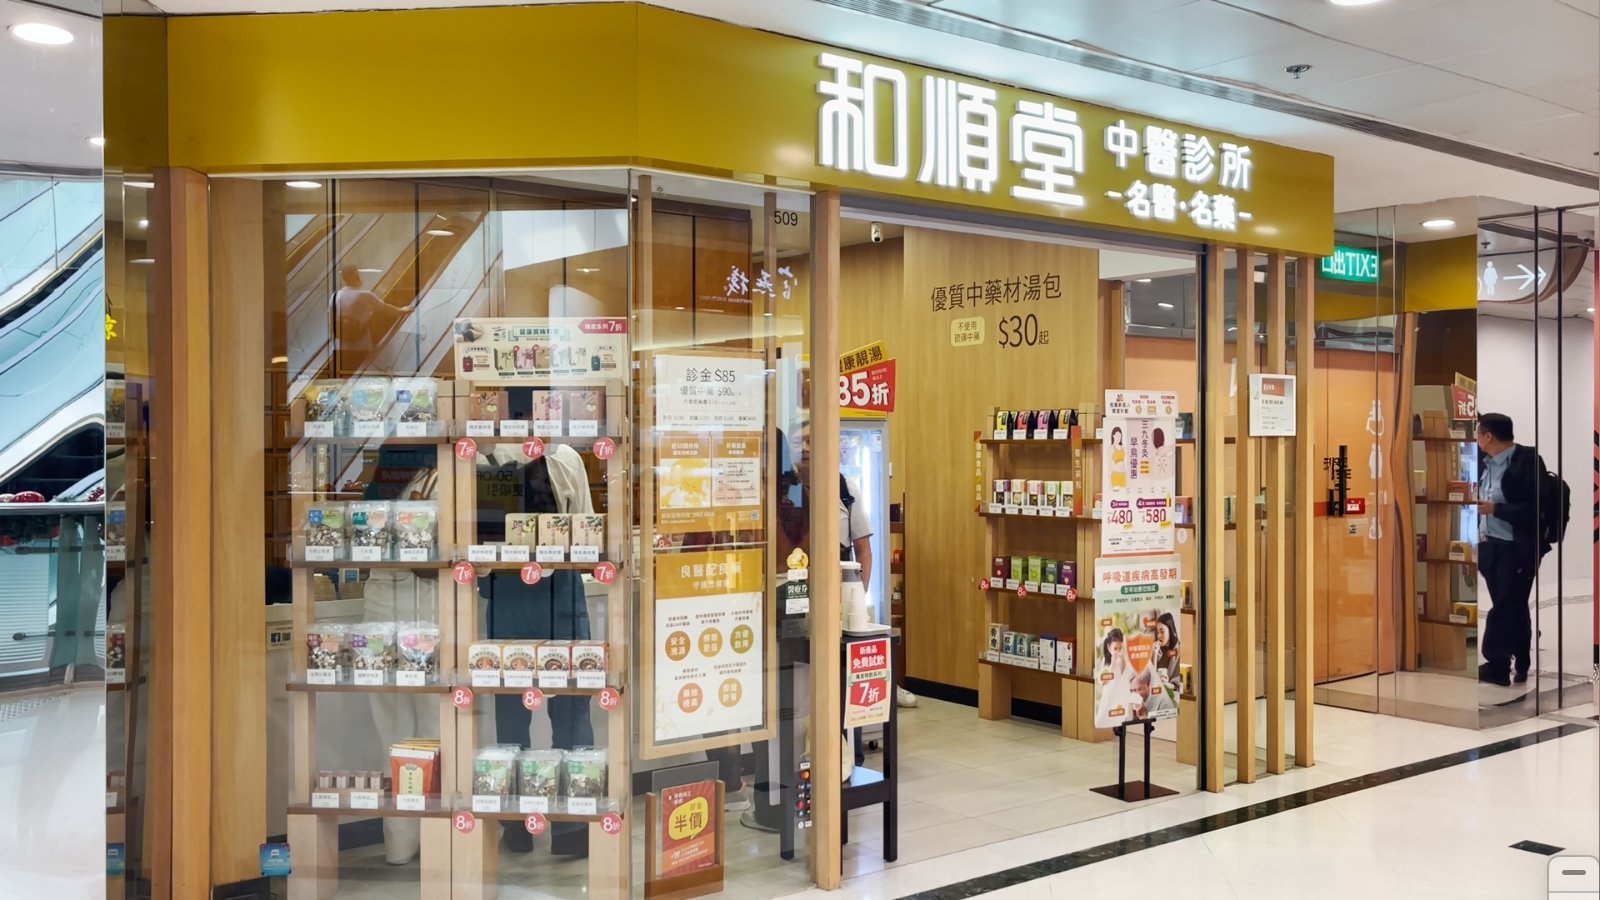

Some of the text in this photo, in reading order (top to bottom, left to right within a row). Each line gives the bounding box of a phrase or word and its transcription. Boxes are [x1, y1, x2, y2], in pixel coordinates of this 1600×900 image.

[817, 51, 1085, 207] 和順堂
[1104, 119, 1252, 190] 中醫診所
[774, 211, 798, 226] 509
[931, 272, 1062, 312] 優質中藥材湯包
[957, 321, 978, 332] 不使用
[686, 367, 736, 383] 診金 $85
[459, 442, 473, 456] 7折
[526, 442, 541, 456] 7折
[597, 442, 613, 456] 7折
[1107, 509, 1166, 524] $480 $580
[457, 566, 472, 581] 7折
[523, 566, 540, 581] 7折
[597, 566, 614, 581] 7折
[1102, 568, 1177, 583] 呼吸道疾病高發期
[860, 645, 878, 655] 新產品
[853, 655, 884, 669] 免費試飲
[454, 689, 470, 705] 8折
[526, 691, 541, 706] 8折
[600, 691, 617, 706] 8折
[860, 682, 880, 704] 7折
[456, 815, 473, 830] 8折
[527, 816, 544, 831] 8折
[603, 817, 620, 832] 8折
[674, 812, 702, 833] 半價
